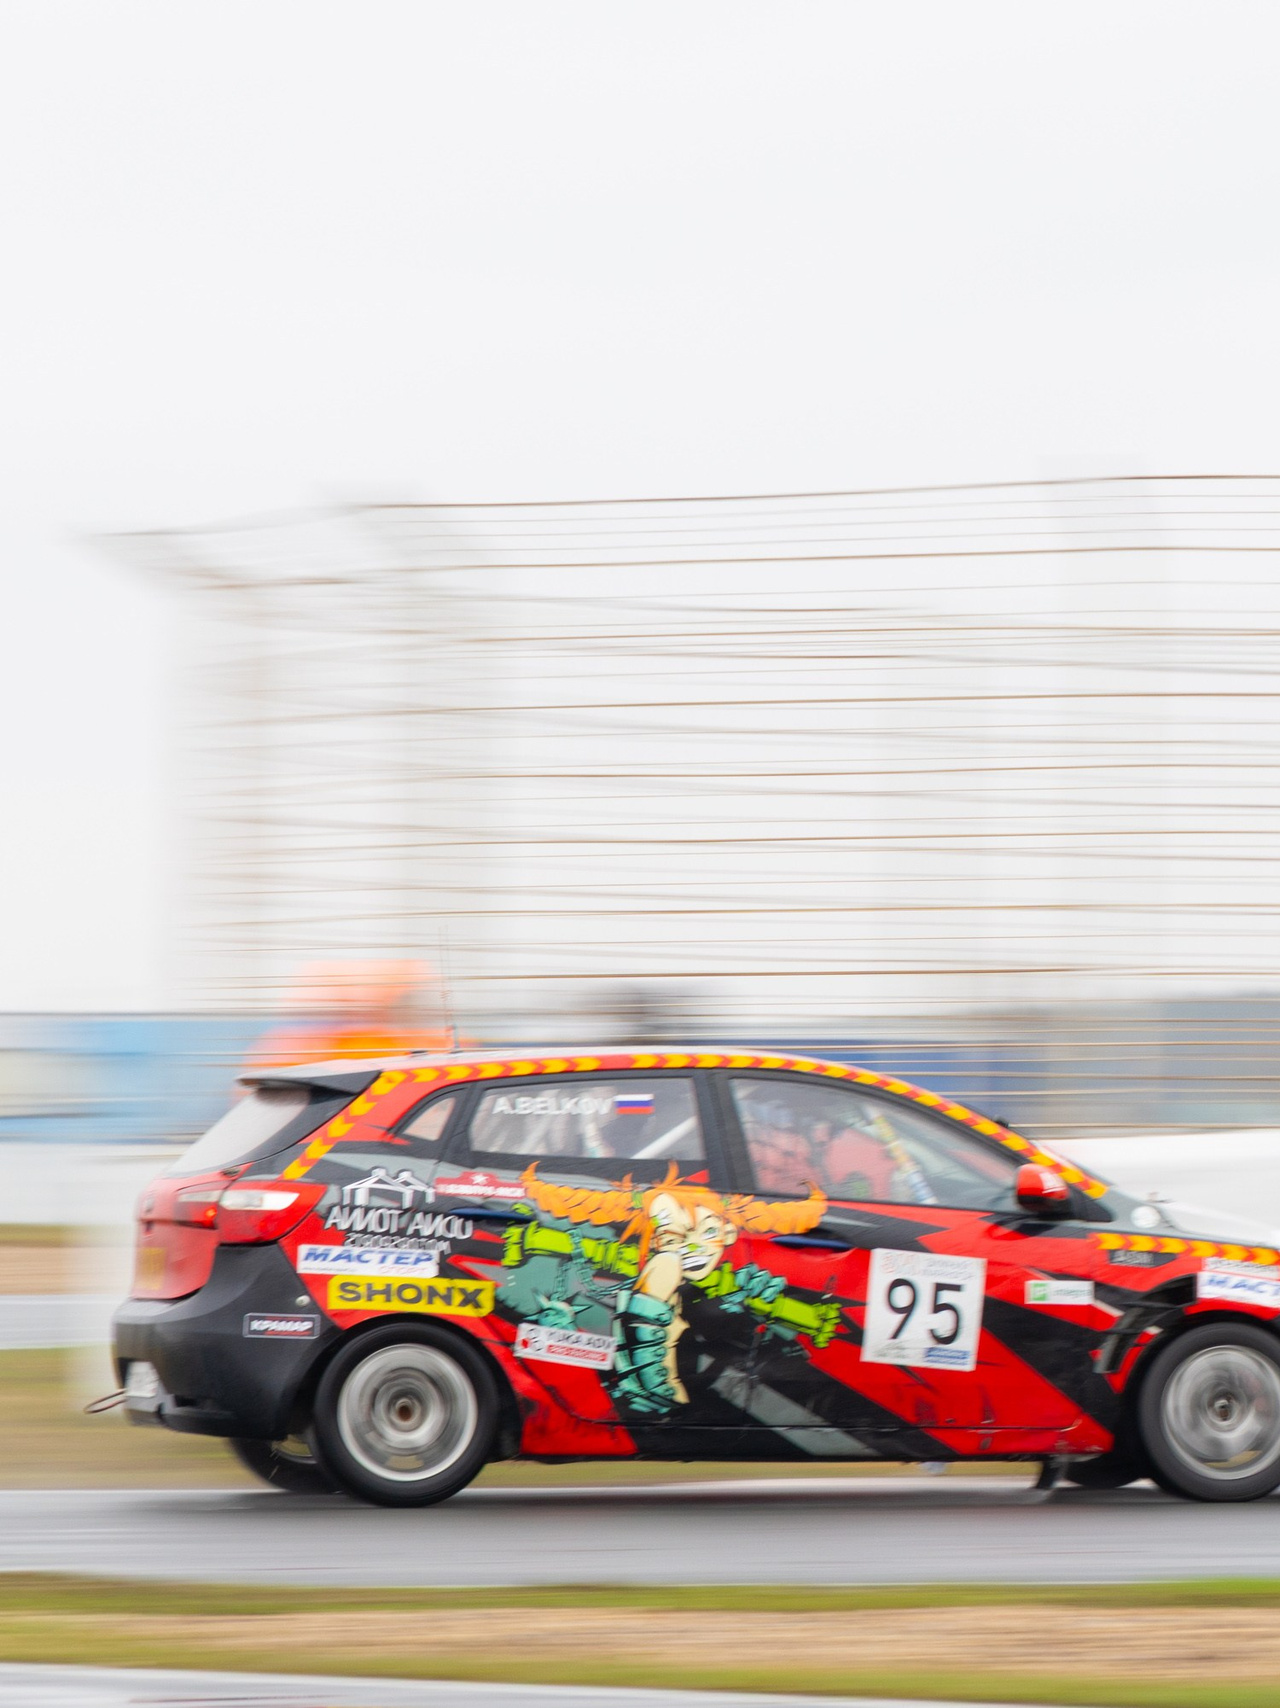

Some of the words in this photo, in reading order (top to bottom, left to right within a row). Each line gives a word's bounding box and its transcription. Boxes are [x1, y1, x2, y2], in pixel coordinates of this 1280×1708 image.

[492, 1096, 614, 1115] A.BELKOV
[338, 1281, 486, 1309] SHONX
[886, 1277, 965, 1345] 95
